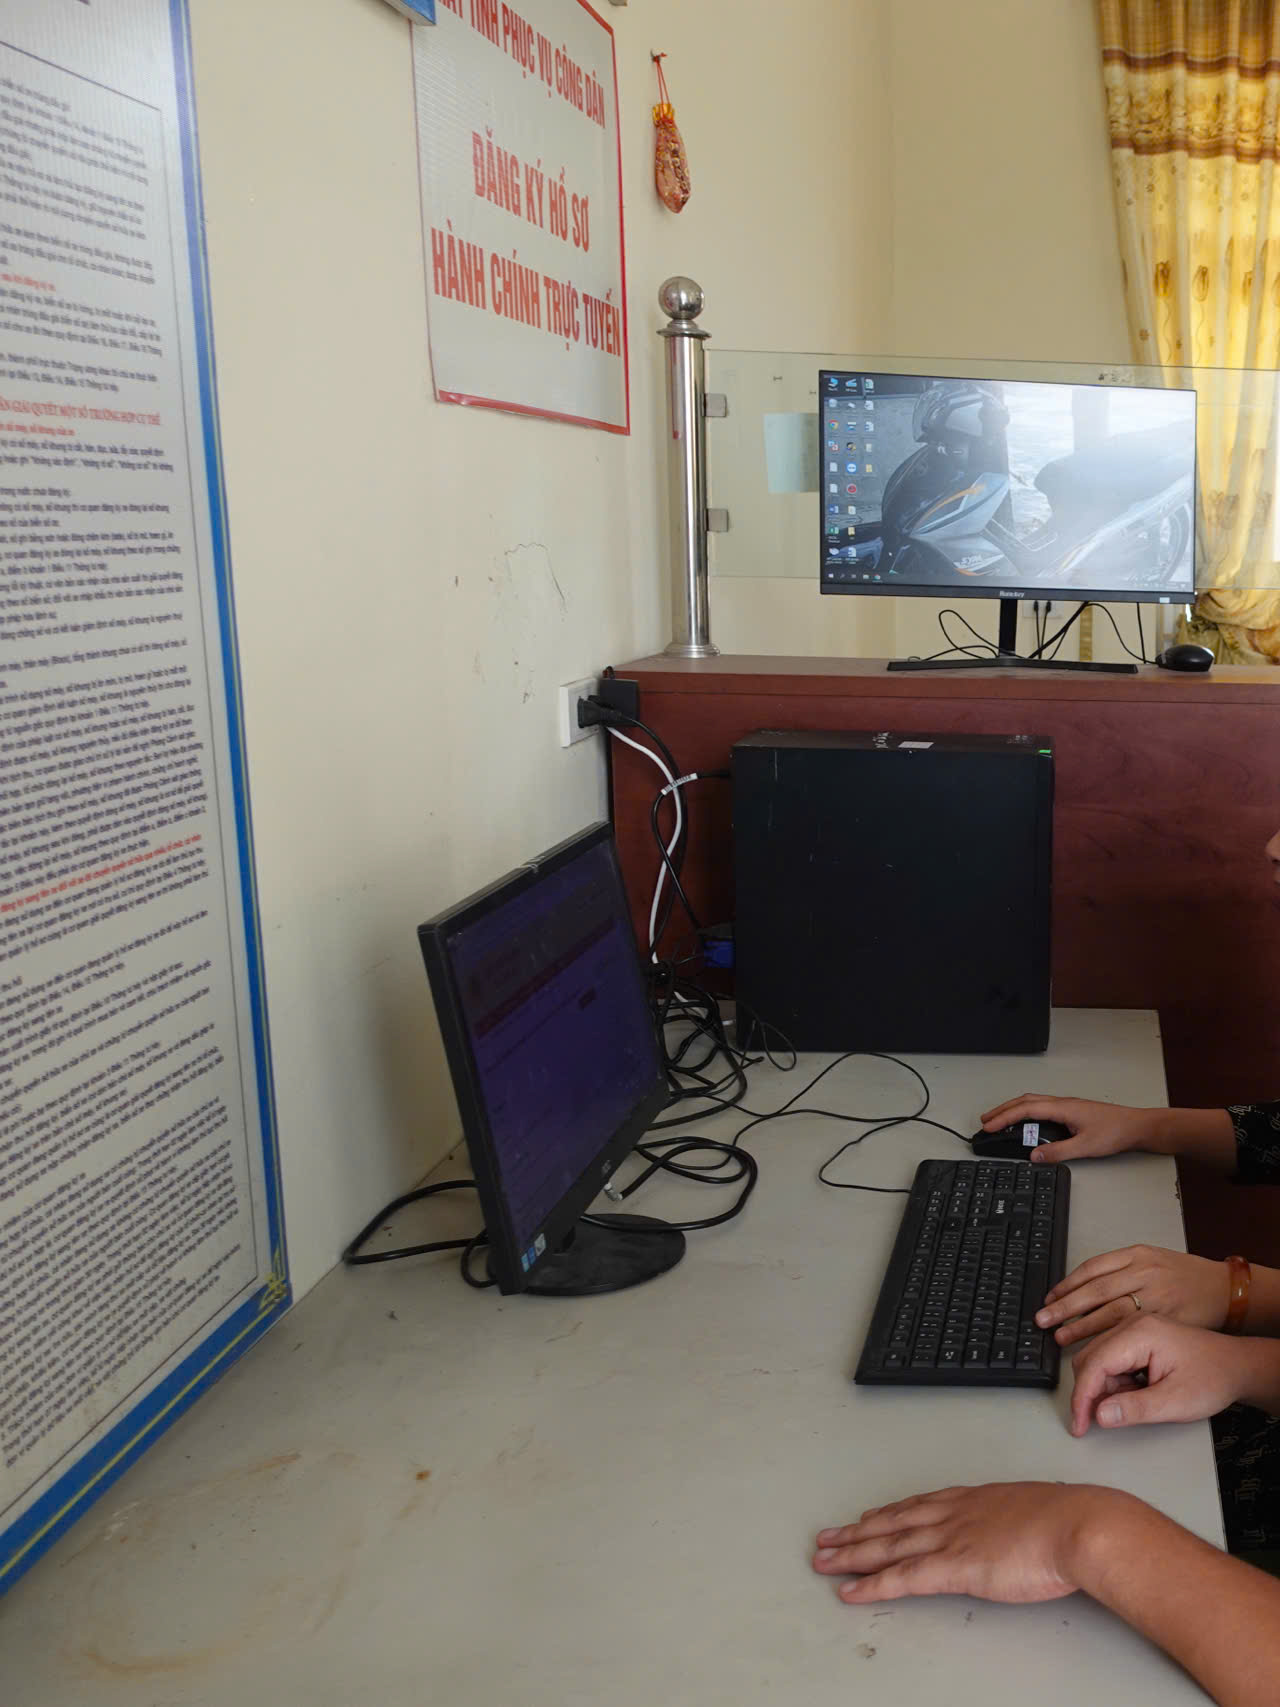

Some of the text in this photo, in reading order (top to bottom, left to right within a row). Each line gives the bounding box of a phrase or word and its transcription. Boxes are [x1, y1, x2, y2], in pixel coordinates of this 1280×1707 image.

[502, 2, 535, 79] PHỤC
[537, 31, 553, 98] VỤ
[555, 43, 583, 112] CÔNG
[585, 70, 605, 128] DÂN
[472, 125, 589, 253] ĐĂNG KÝ HỒ SƠ
[431, 218, 621, 357] HÀNH CHÍNH TRỰC TUYẾN
